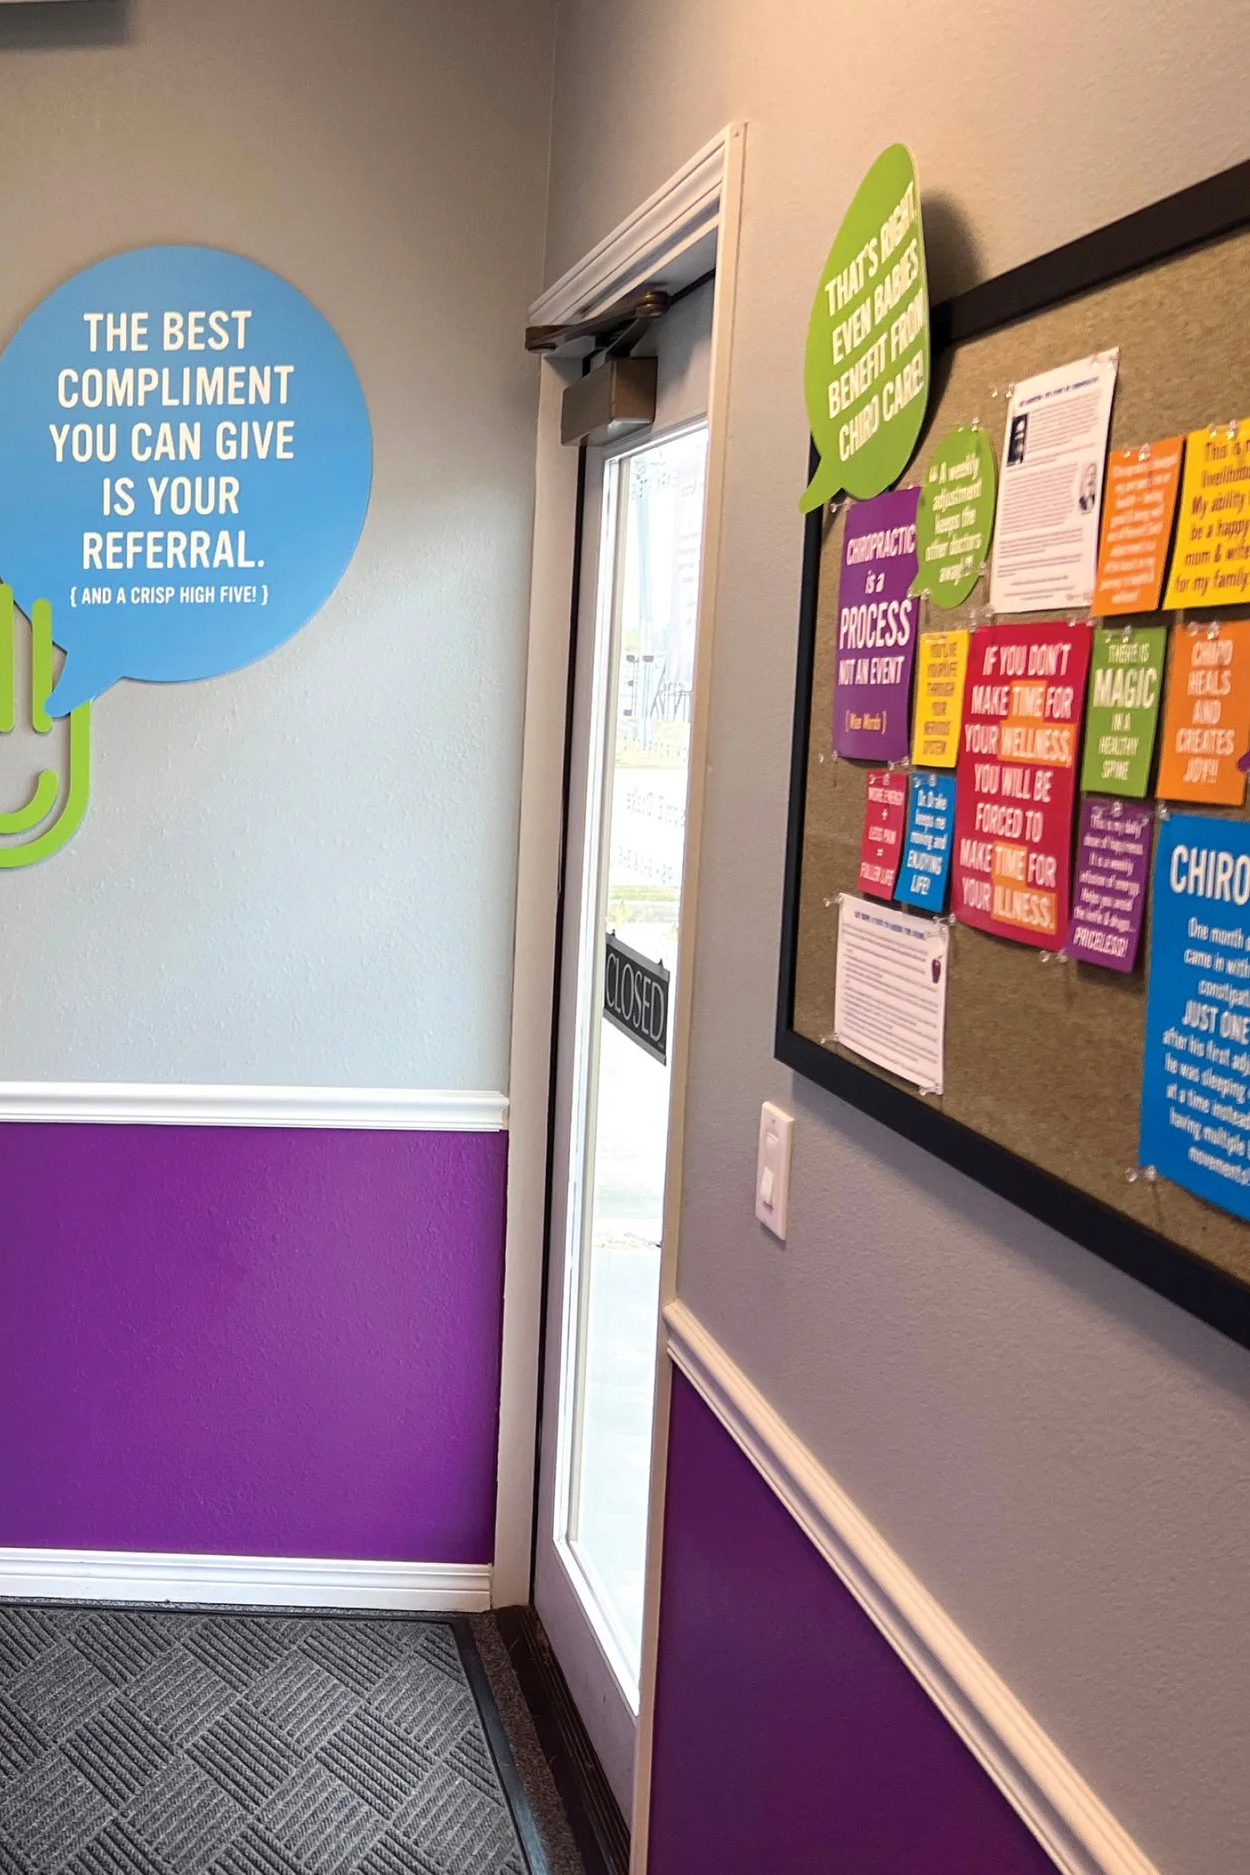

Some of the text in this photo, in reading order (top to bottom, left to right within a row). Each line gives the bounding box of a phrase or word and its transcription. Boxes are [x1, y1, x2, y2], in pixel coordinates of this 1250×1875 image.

[825, 236, 880, 317] THAT'S
[832, 238, 919, 365] EVEN BABIES
[83, 310, 252, 352] THE BEST
[828, 288, 925, 419] BENEFIT FROM
[57, 365, 294, 408] COMPLIMENT
[838, 350, 925, 462] CHIRO CARE!
[49, 421, 294, 462] YOU CAN GIVE
[102, 476, 239, 516] IS YOUR
[932, 477, 982, 512] adjustment
[1191, 495, 1208, 520] My
[1211, 490, 1245, 517] ability
[961, 505, 977, 527] the
[1190, 524, 1203, 541] be
[1206, 526, 1214, 538] a
[83, 530, 265, 569] REFERRAL.
[846, 524, 916, 566] CHIROPRACTIC
[1184, 552, 1211, 567] mom
[1214, 544, 1222, 563] &
[82, 588, 112, 605] AND
[116, 587, 127, 604] A
[131, 586, 175, 604] CRISP
[179, 586, 215, 603] HIGH
[220, 585, 257, 603] FIVE!
[865, 569, 885, 594] is a
[1175, 573, 1190, 592] for
[1193, 577, 1209, 596] my
[839, 599, 912, 650] PROCESS
[982, 643, 1071, 676] IF YOU DON'T
[1108, 643, 1149, 663] THERE IS
[1191, 640, 1233, 666] CHIRO
[838, 656, 905, 686] NOT AN EVENT
[1093, 667, 1157, 709] MAGIC
[1187, 669, 1231, 696] HEALS
[971, 685, 1074, 719] MAKE TIME FOR
[1192, 700, 1222, 724] AND
[964, 724, 999, 754] YOUR
[1111, 713, 1131, 731] IN A
[1098, 736, 1139, 756] HEALTHY
[1175, 727, 1235, 755] CREATES
[974, 764, 1053, 802] YOU WILL BE
[1102, 760, 1130, 780] SPINE
[975, 803, 1044, 843] FORCED TO
[960, 839, 992, 873] MAKE
[993, 844, 1026, 880] TIME
[1027, 852, 1057, 887] FOR
[961, 876, 992, 911] YOUR
[1188, 916, 1208, 940] One
[1210, 926, 1243, 949] month
[1184, 949, 1212, 969] came
[1213, 953, 1224, 972] in
[606, 952, 664, 1042] CLOSED
[1182, 999, 1250, 1045] JUST ONE
[1162, 1026, 1188, 1051] after
[1188, 1035, 1205, 1057] his
[1206, 1040, 1230, 1066] first
[1164, 1052, 1178, 1074] he
[1179, 1063, 1200, 1083] was
[1201, 1068, 1247, 1104] sleeping
[1166, 1083, 1177, 1100] at
[1178, 1088, 1186, 1104] a
[1187, 1088, 1210, 1114] time
[1169, 1105, 1202, 1141] having
[1203, 1126, 1246, 1156] multiple
